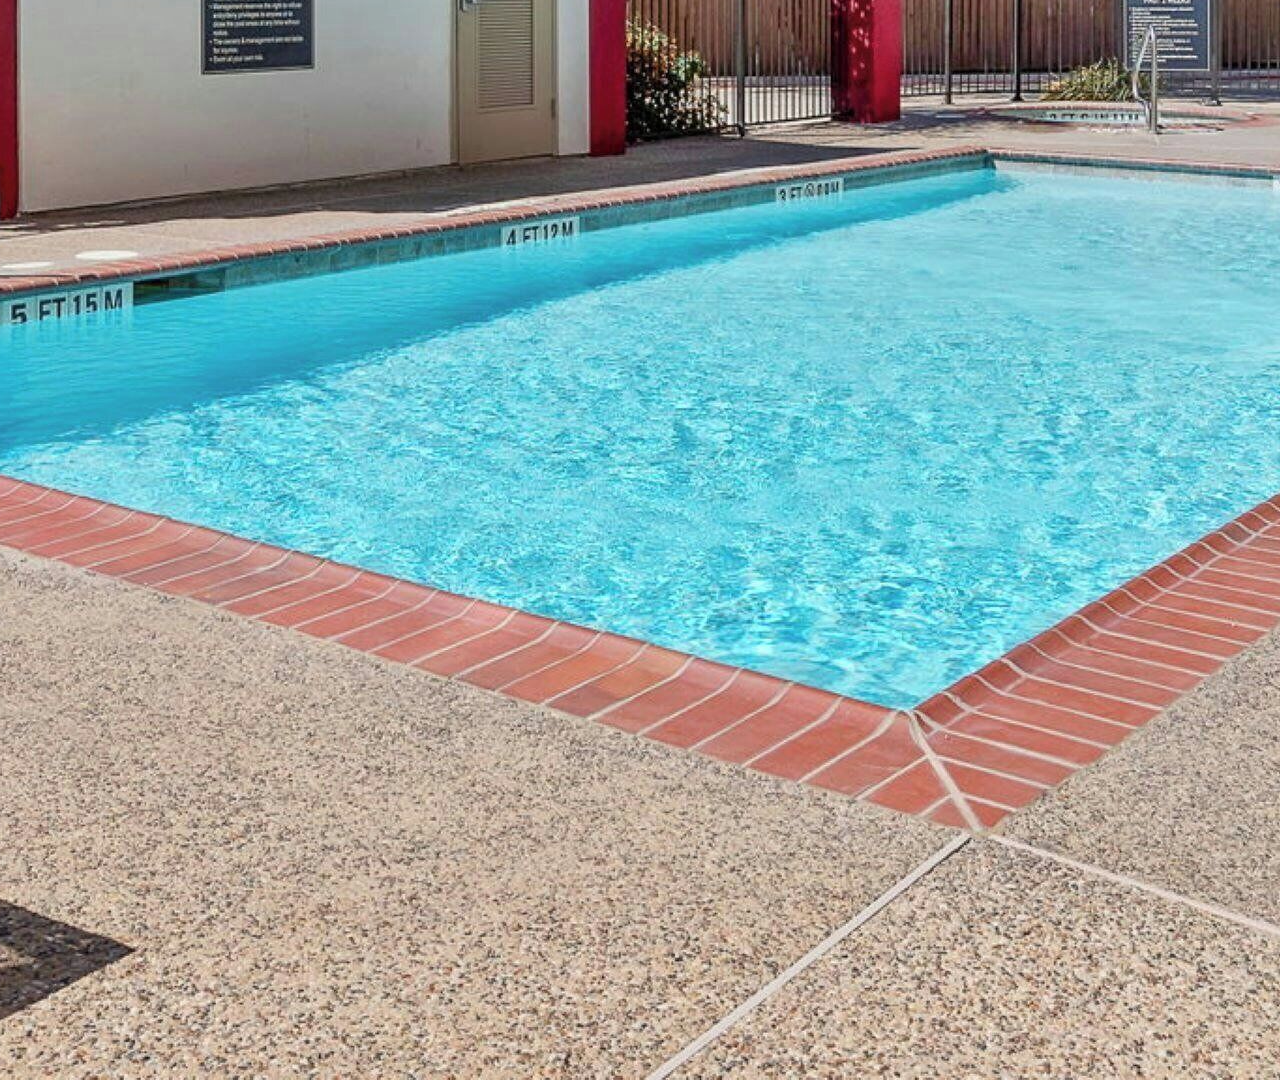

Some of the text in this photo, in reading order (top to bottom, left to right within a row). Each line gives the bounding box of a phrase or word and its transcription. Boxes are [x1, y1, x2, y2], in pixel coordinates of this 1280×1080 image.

[506, 228, 517, 246] 4
[523, 226, 539, 243] FT
[11, 303, 27, 324] 5
[39, 297, 67, 321] FT
